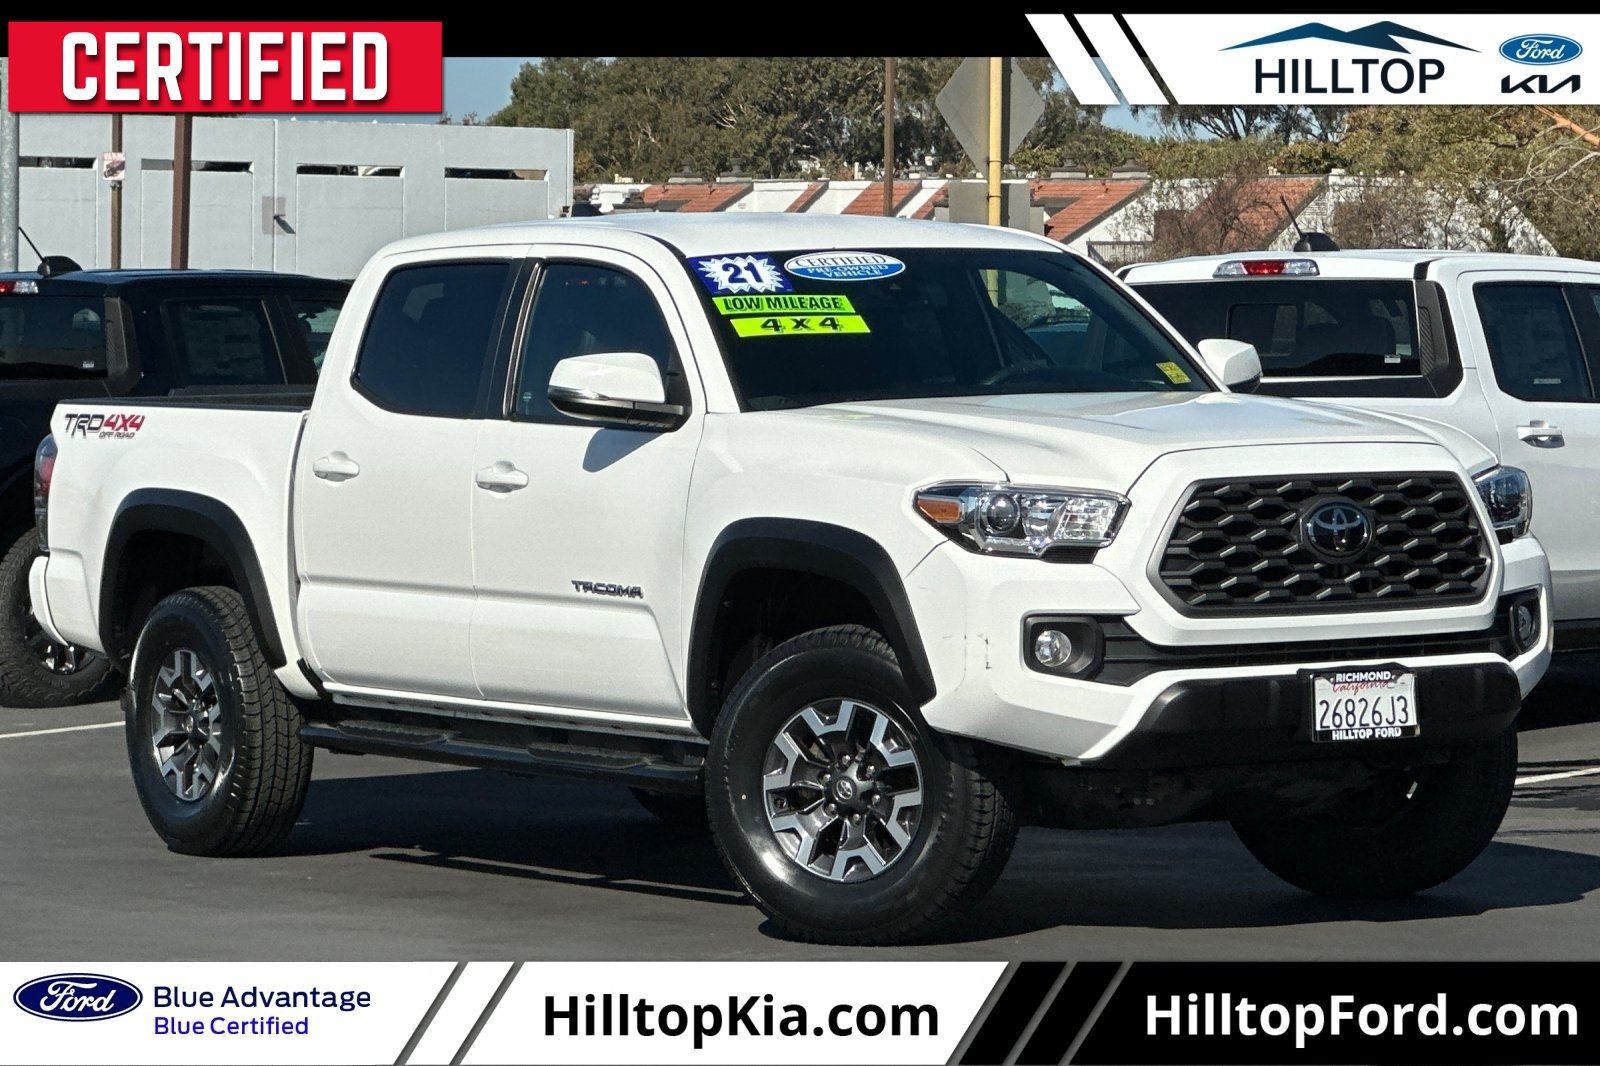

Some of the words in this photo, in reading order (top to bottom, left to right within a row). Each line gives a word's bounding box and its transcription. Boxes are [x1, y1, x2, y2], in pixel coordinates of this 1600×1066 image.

[795, 255, 887, 268] CERTIFIED
[721, 261, 763, 285] 21
[806, 264, 889, 274] PRE-OWNED
[822, 269, 883, 279] VEHICLE
[723, 297, 762, 311] LOW
[766, 296, 844, 311] MILEAGE
[98, 431, 114, 440] OFF
[114, 431, 136, 440] ROAD
[570, 579, 644, 599] TACOMA
[1336, 671, 1392, 683] RICHMOND
[1319, 695, 1409, 729] 26826J3
[1332, 728, 1374, 740] HILLTOP
[1375, 726, 1402, 738] FORD
